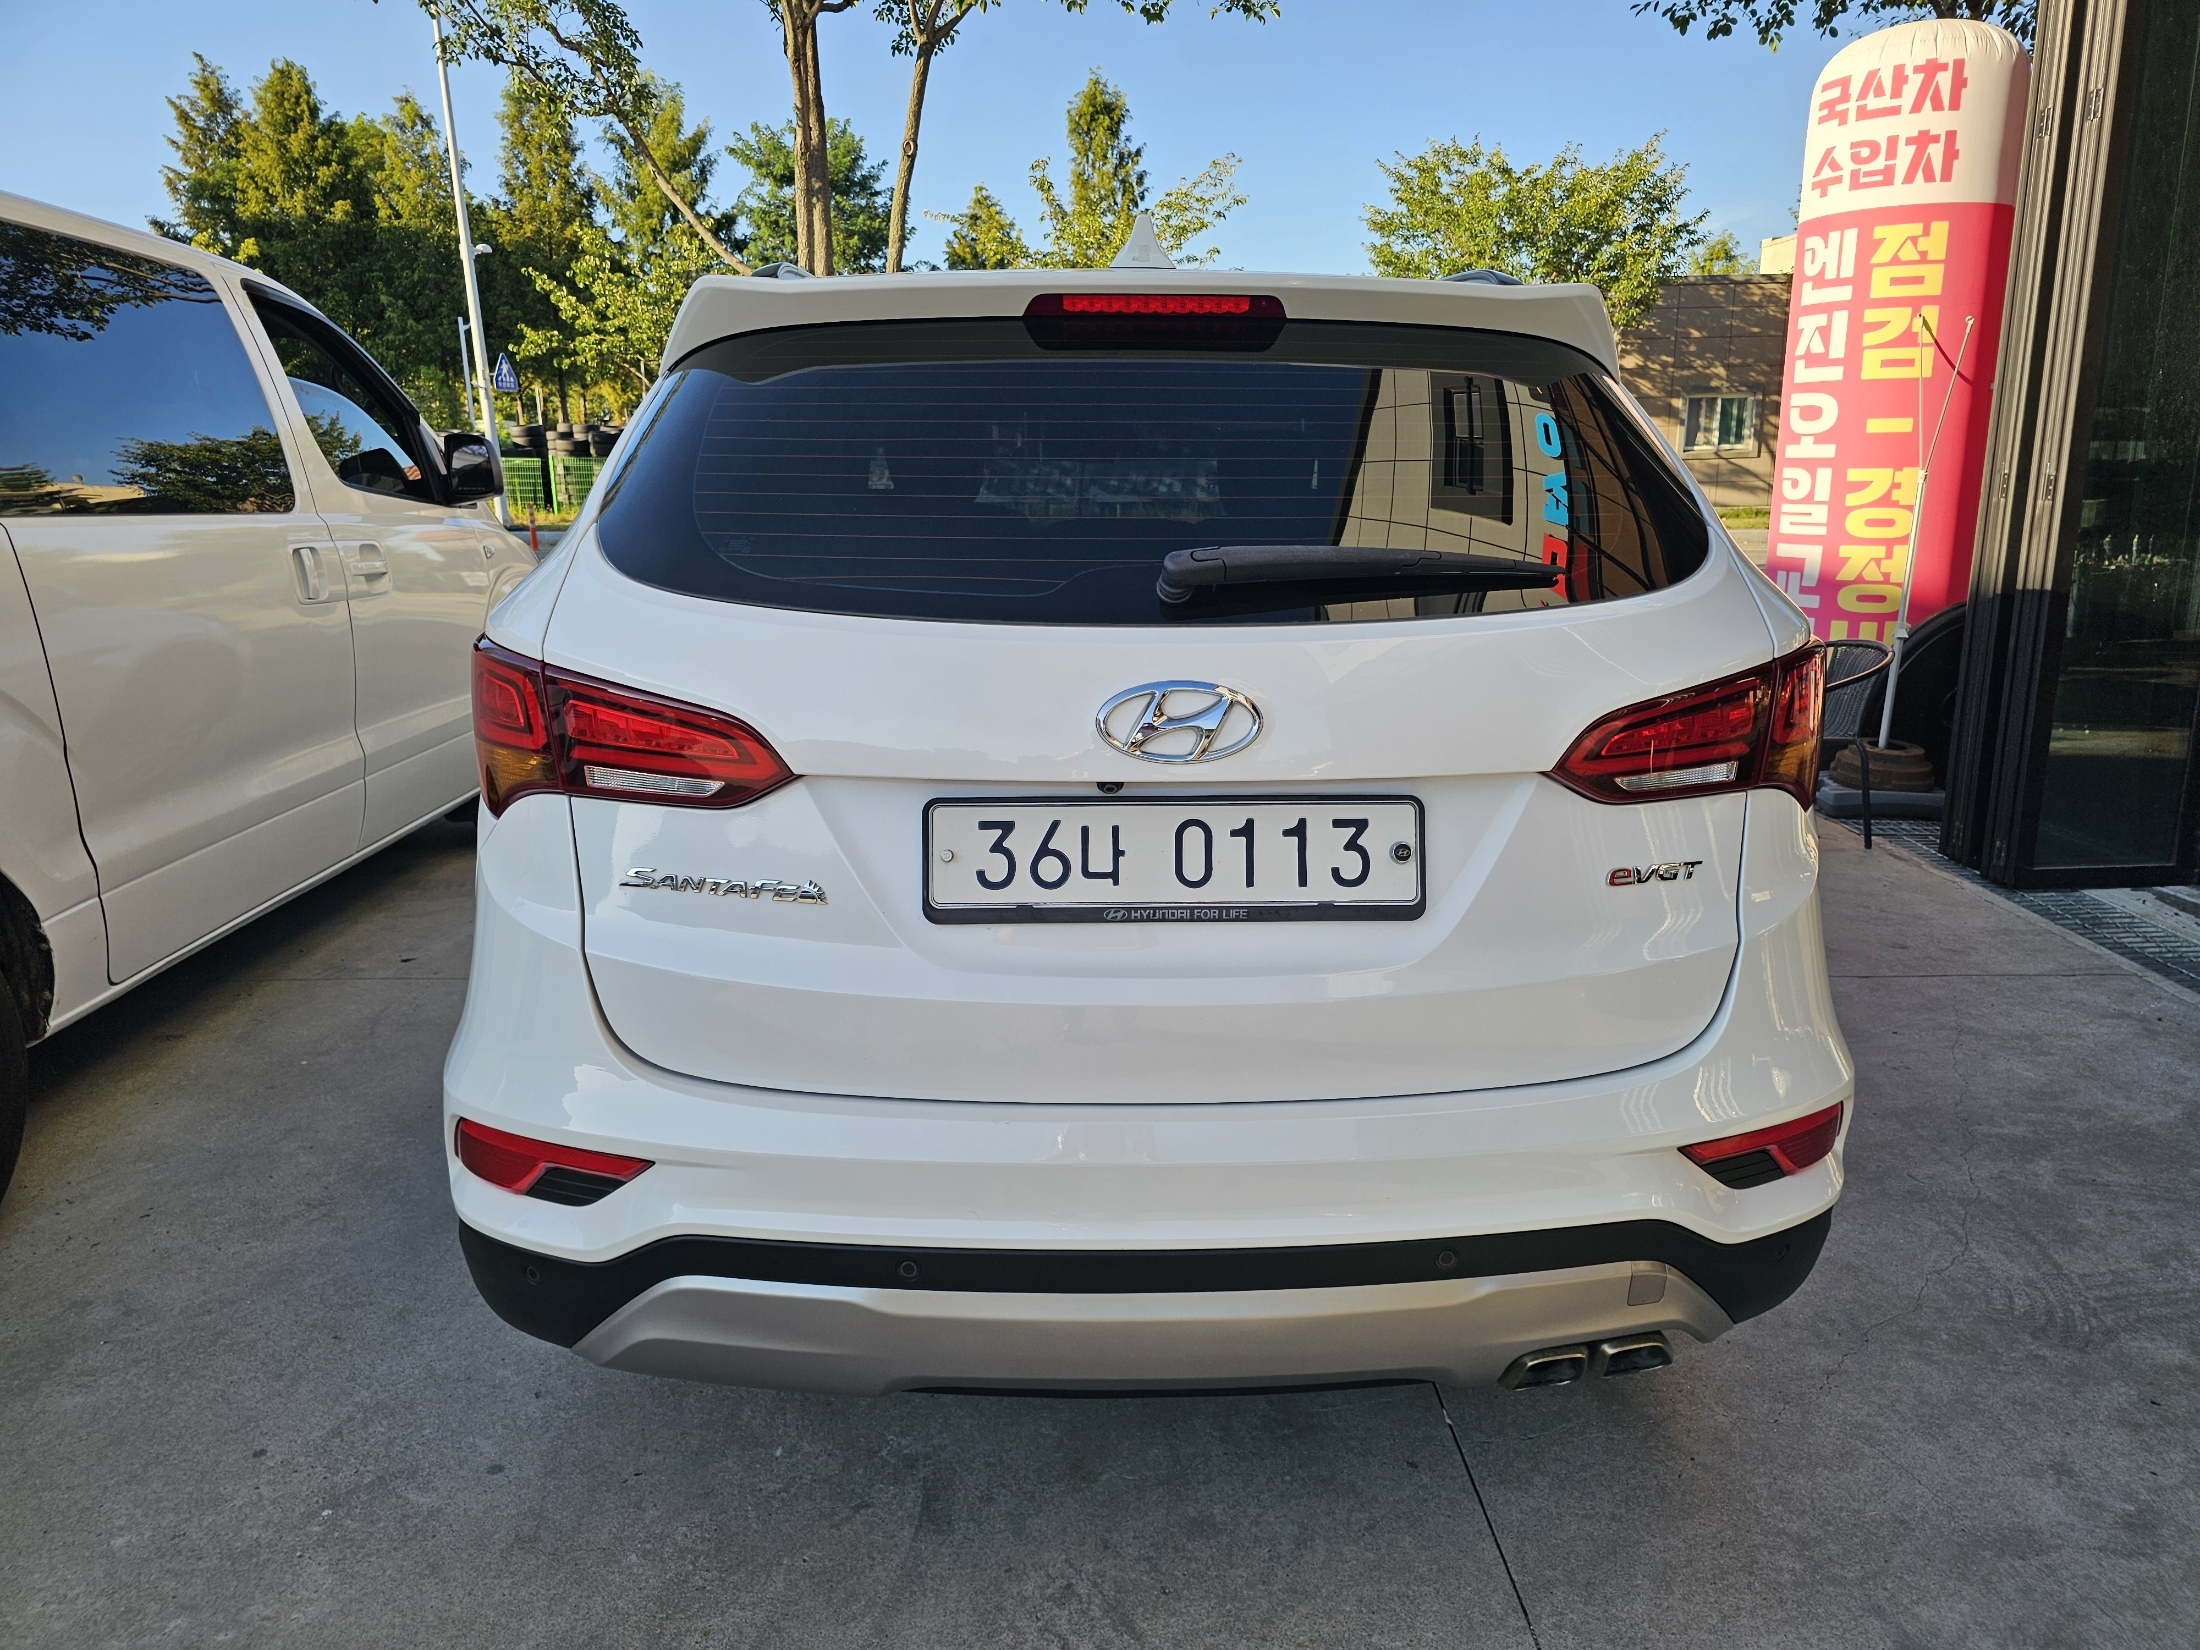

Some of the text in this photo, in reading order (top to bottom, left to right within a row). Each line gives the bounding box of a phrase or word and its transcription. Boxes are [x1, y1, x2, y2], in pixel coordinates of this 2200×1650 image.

[1818, 57, 1968, 127] 국산차
[1811, 129, 1960, 198] 수입차
[1776, 227, 1859, 637] 엔진오일교
[975, 817, 1372, 891] 36나 0113
[1131, 909, 1248, 920] HYUNDAI FOR LIFE
